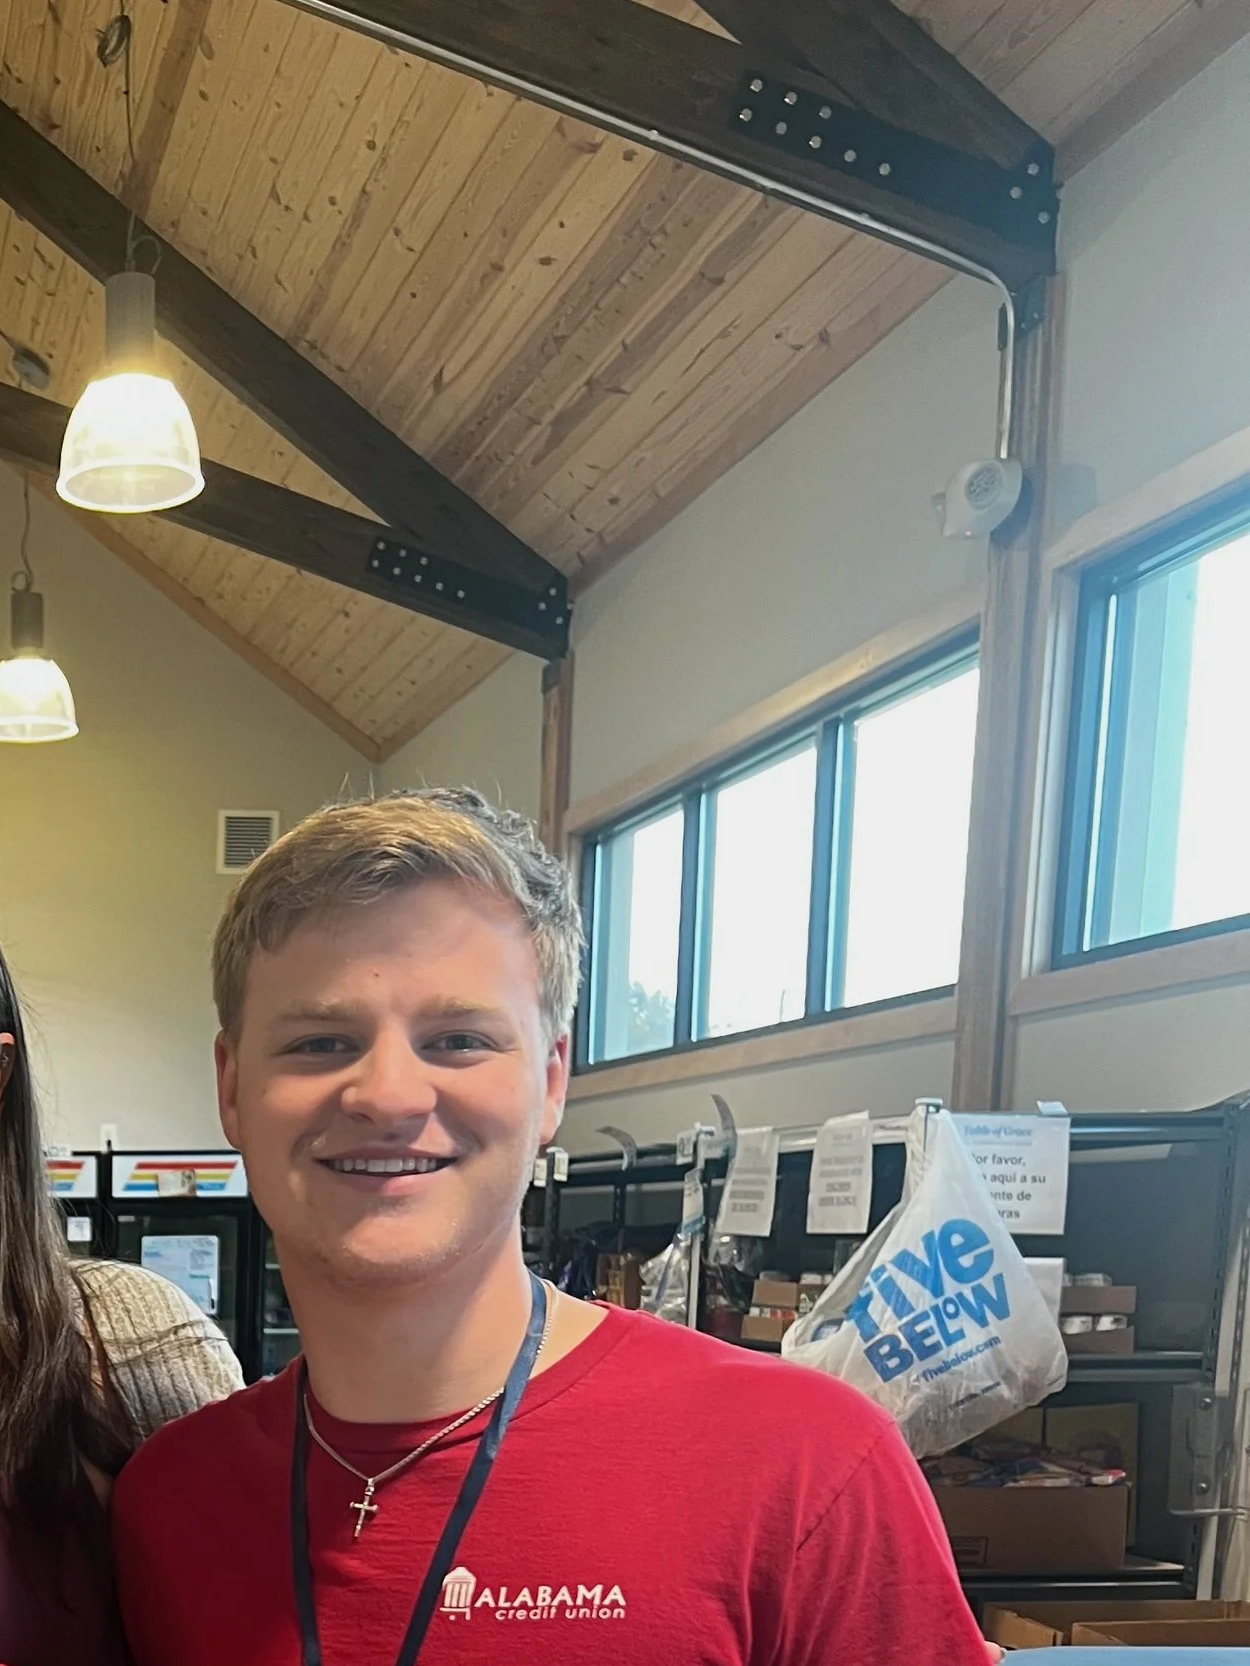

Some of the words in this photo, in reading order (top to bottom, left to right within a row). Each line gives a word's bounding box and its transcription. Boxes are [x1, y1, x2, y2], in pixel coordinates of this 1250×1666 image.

[991, 1152, 1027, 1167] favor,
[1019, 1174, 1028, 1184] a
[1030, 1174, 1047, 1184] su
[1016, 1190, 1033, 1201] de
[863, 1272, 1011, 1383] BELOW
[474, 1584, 626, 1608] ALABAMA
[495, 1606, 556, 1621] credit
[564, 1604, 626, 1620] union
